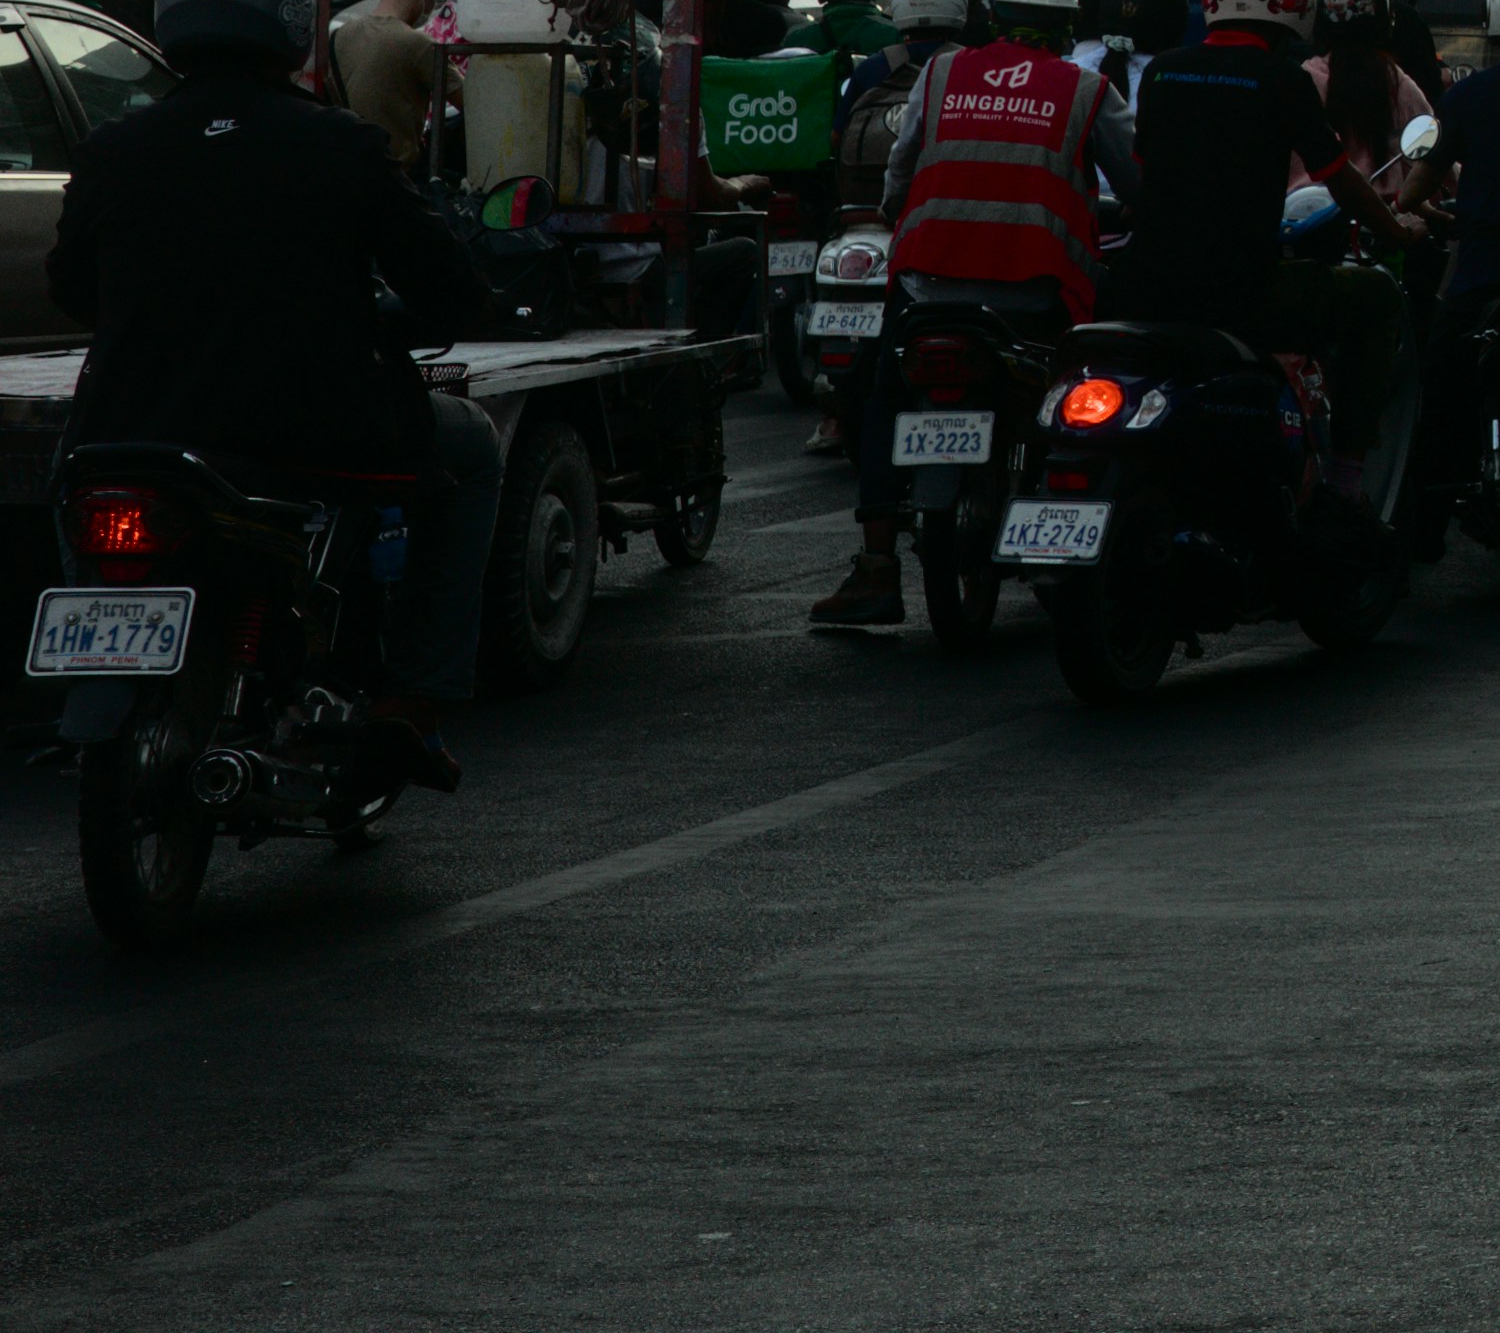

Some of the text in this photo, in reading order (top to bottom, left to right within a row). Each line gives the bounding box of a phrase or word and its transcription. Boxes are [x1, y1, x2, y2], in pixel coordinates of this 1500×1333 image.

[1163, 72, 1261, 90] HYUNDAI ELEVATOR
[728, 90, 798, 119] Grab
[943, 93, 1056, 119] SINGBUILD
[210, 119, 236, 129] NIKE
[942, 113, 1052, 127] TRUST QUALITY PRECISION
[724, 117, 799, 145] Food
[770, 254, 813, 269] P-5178
[818, 314, 877, 331] 1P-6477
[903, 431, 983, 455] 1X-2223
[1004, 523, 1099, 547] 1KI-2749
[43, 623, 176, 655] 1HW-1779
[69, 656, 139, 665] PHNOM PENH
